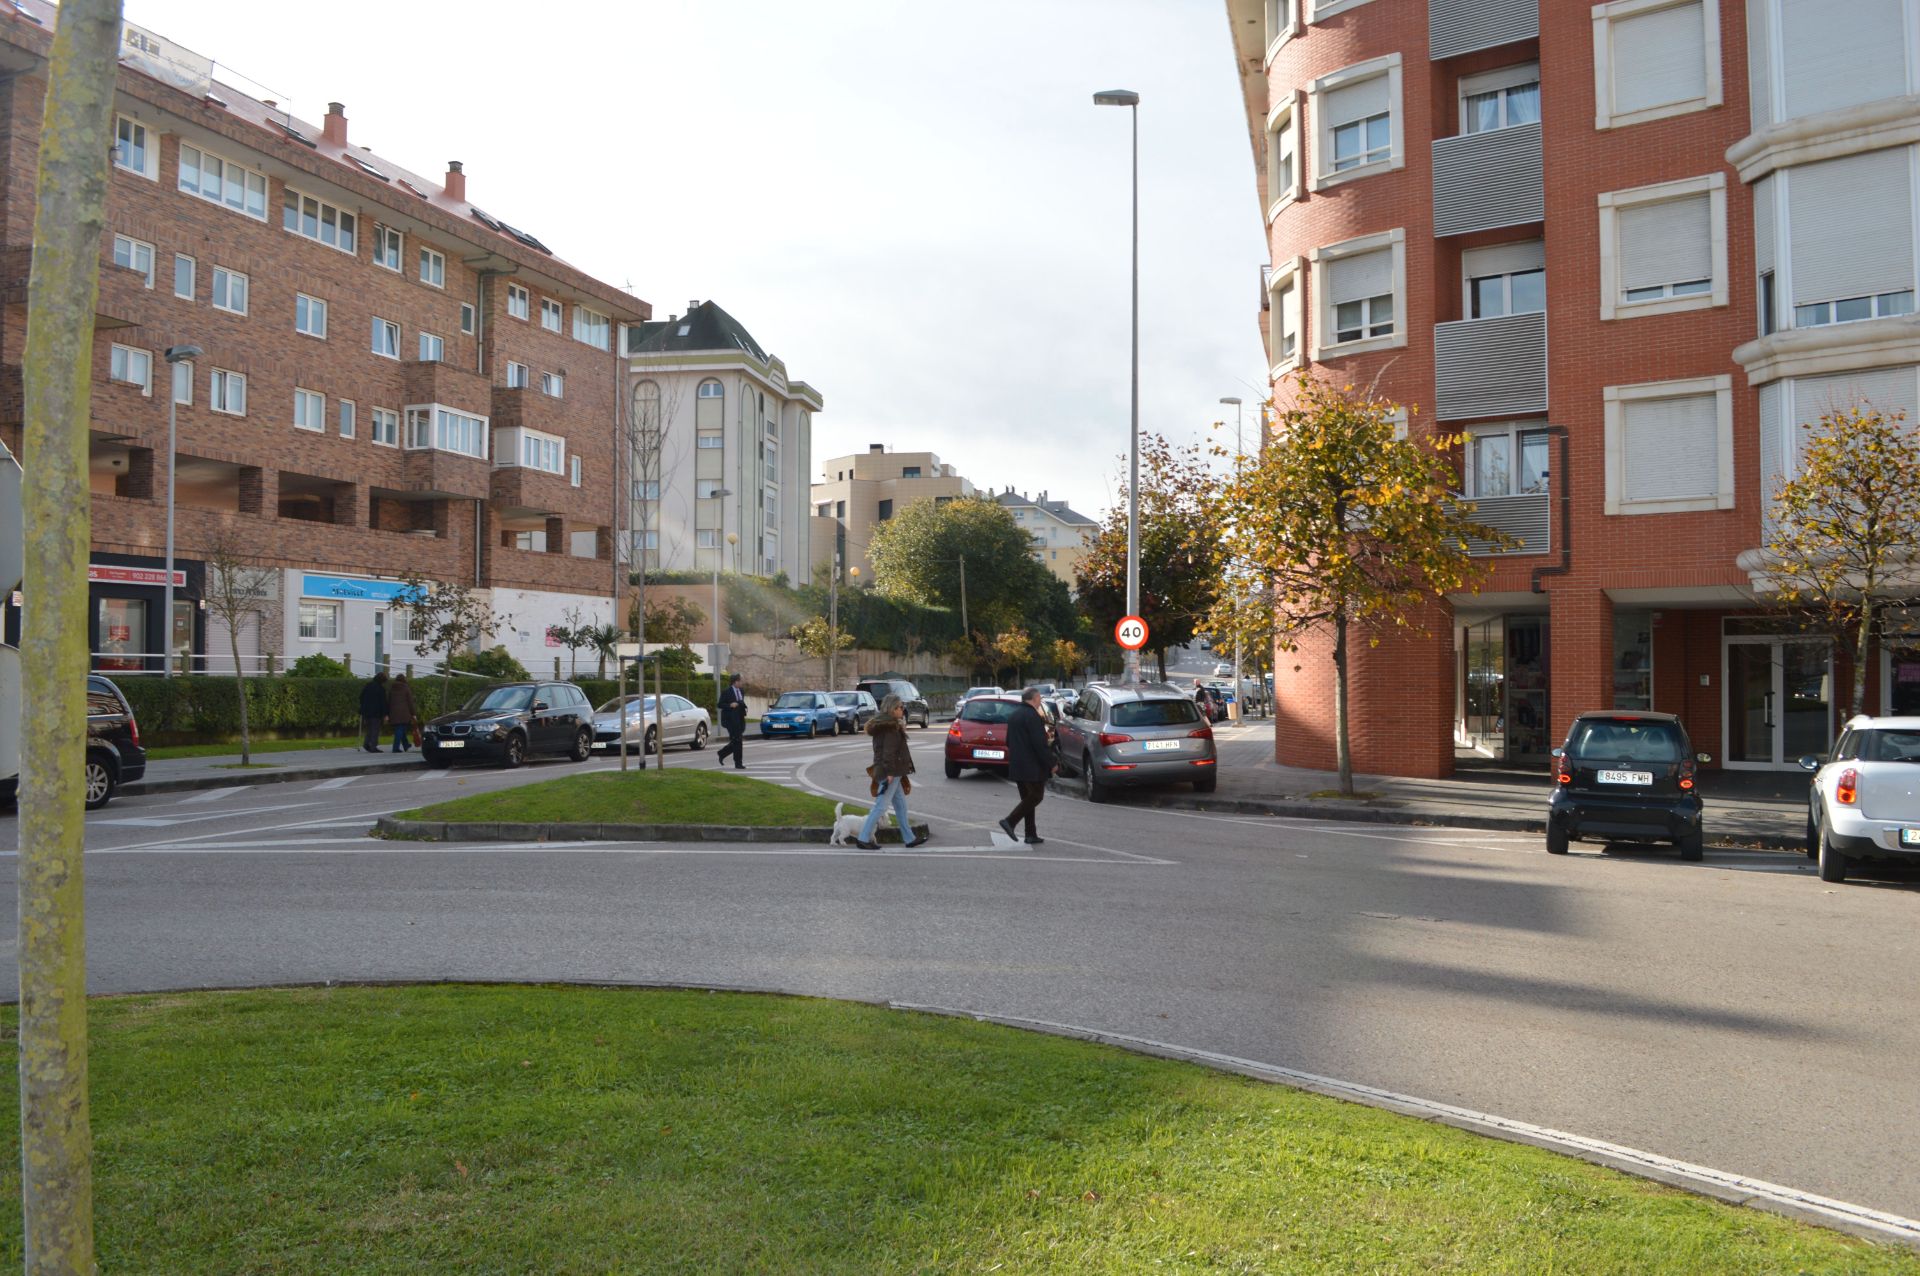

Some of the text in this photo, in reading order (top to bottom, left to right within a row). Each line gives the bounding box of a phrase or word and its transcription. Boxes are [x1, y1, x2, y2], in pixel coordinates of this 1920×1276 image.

[1122, 627, 1141, 638] 40
[1605, 772, 1649, 783] 8495 FMH
